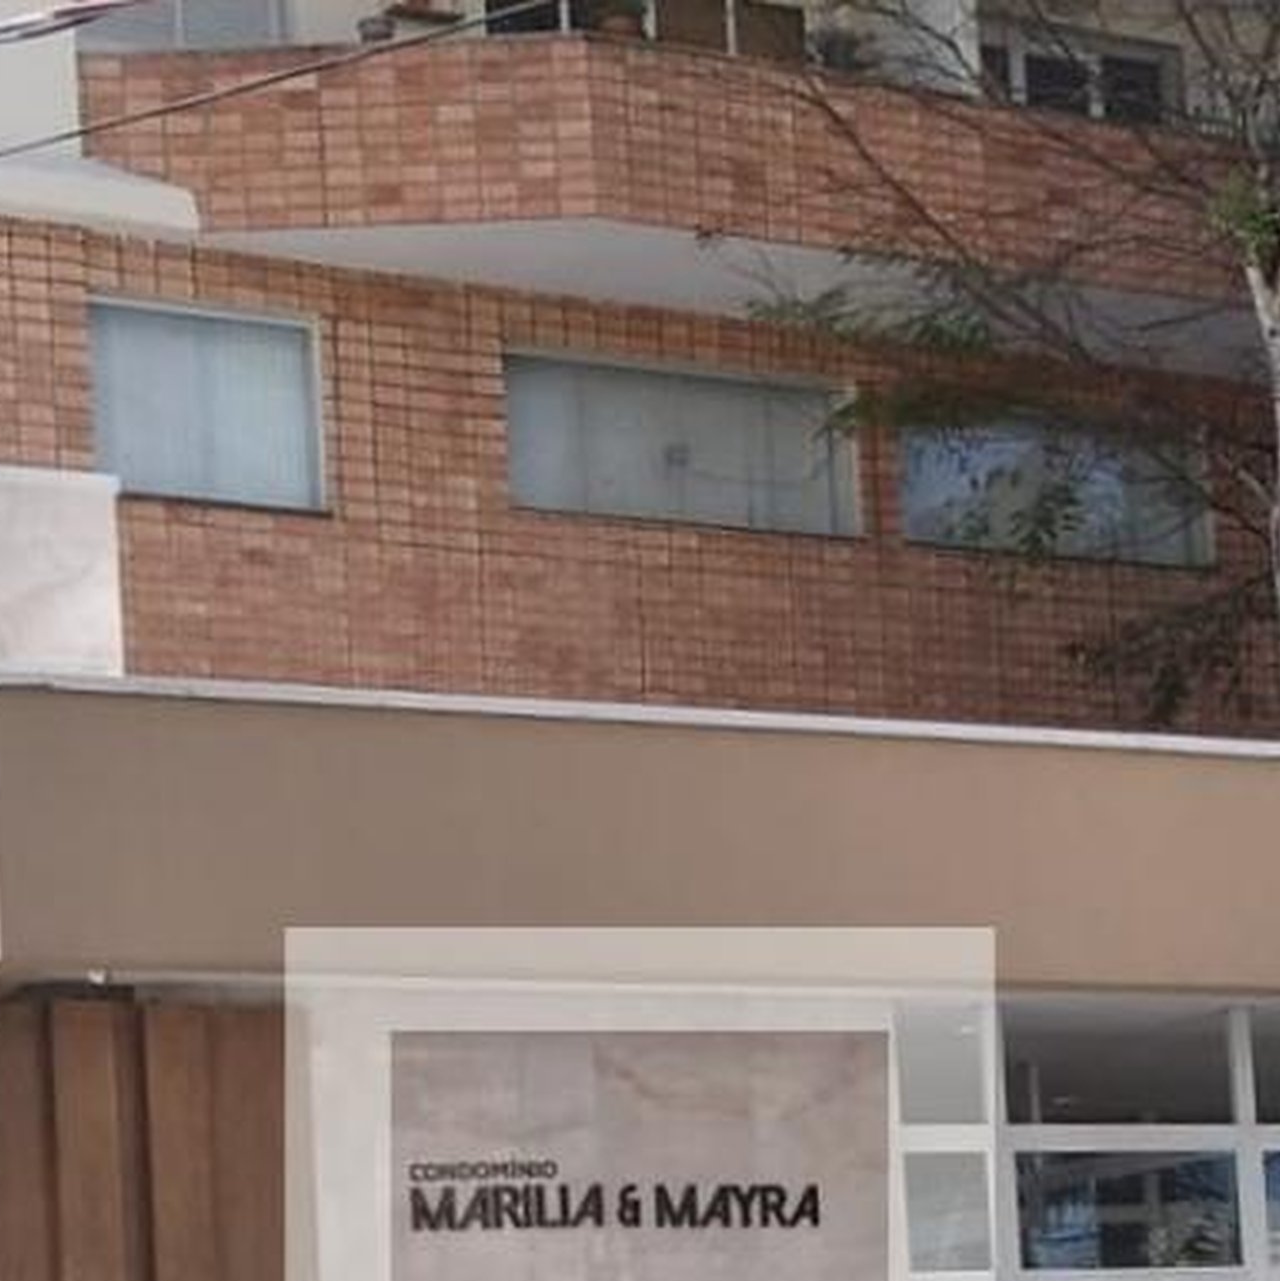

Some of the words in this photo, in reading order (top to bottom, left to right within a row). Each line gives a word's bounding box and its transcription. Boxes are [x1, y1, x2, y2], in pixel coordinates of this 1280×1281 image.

[410, 1183, 604, 1231] MARILIA
[617, 1184, 641, 1228] &
[654, 1184, 820, 1228] MAYRA
